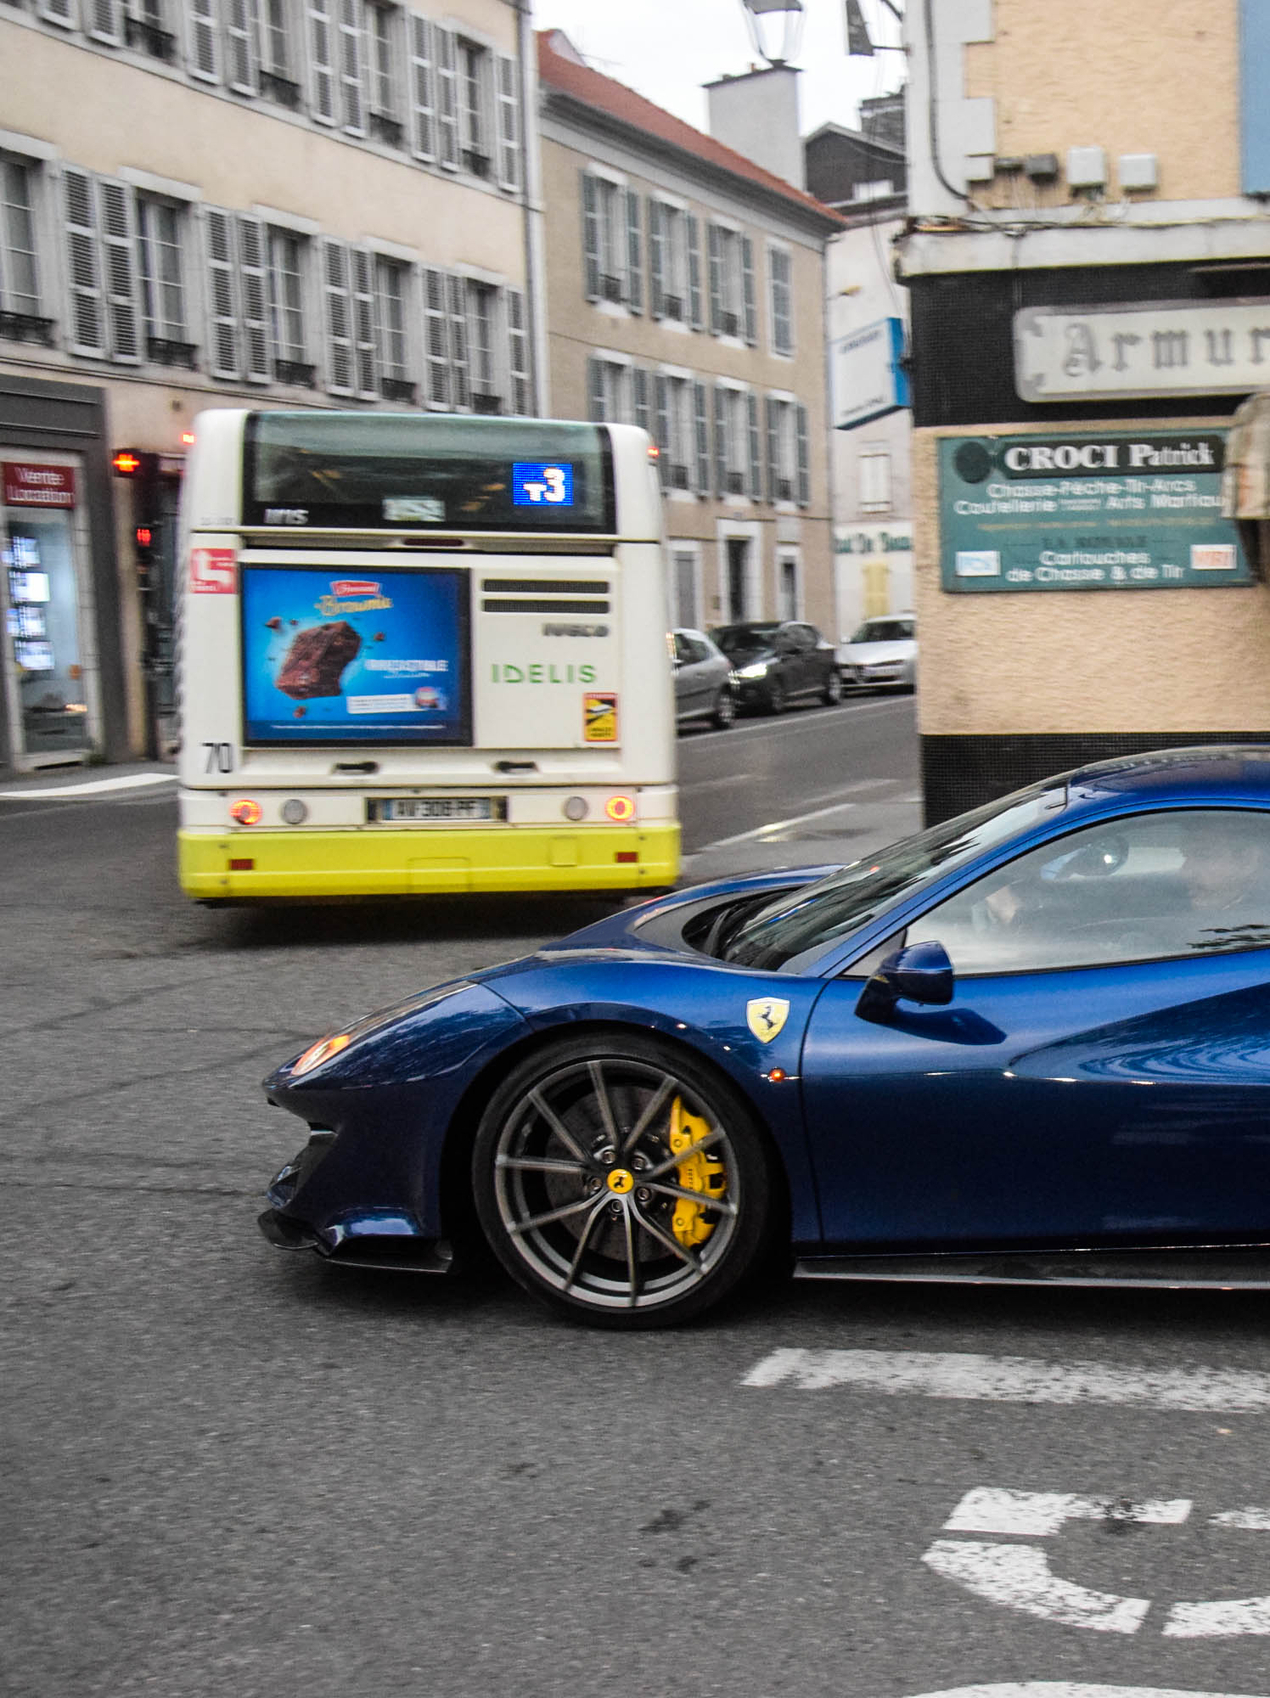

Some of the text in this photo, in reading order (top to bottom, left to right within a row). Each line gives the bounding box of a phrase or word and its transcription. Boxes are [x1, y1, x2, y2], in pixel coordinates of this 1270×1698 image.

[1004, 440, 1215, 473] CROCI Patrick
[1105, 495, 1146, 511] Arts
[1039, 550, 1152, 567] Cartouches
[1005, 566, 1035, 583] de
[1036, 565, 1106, 582] Chasse
[1132, 563, 1160, 581] de
[491, 663, 597, 684] IDELIS
